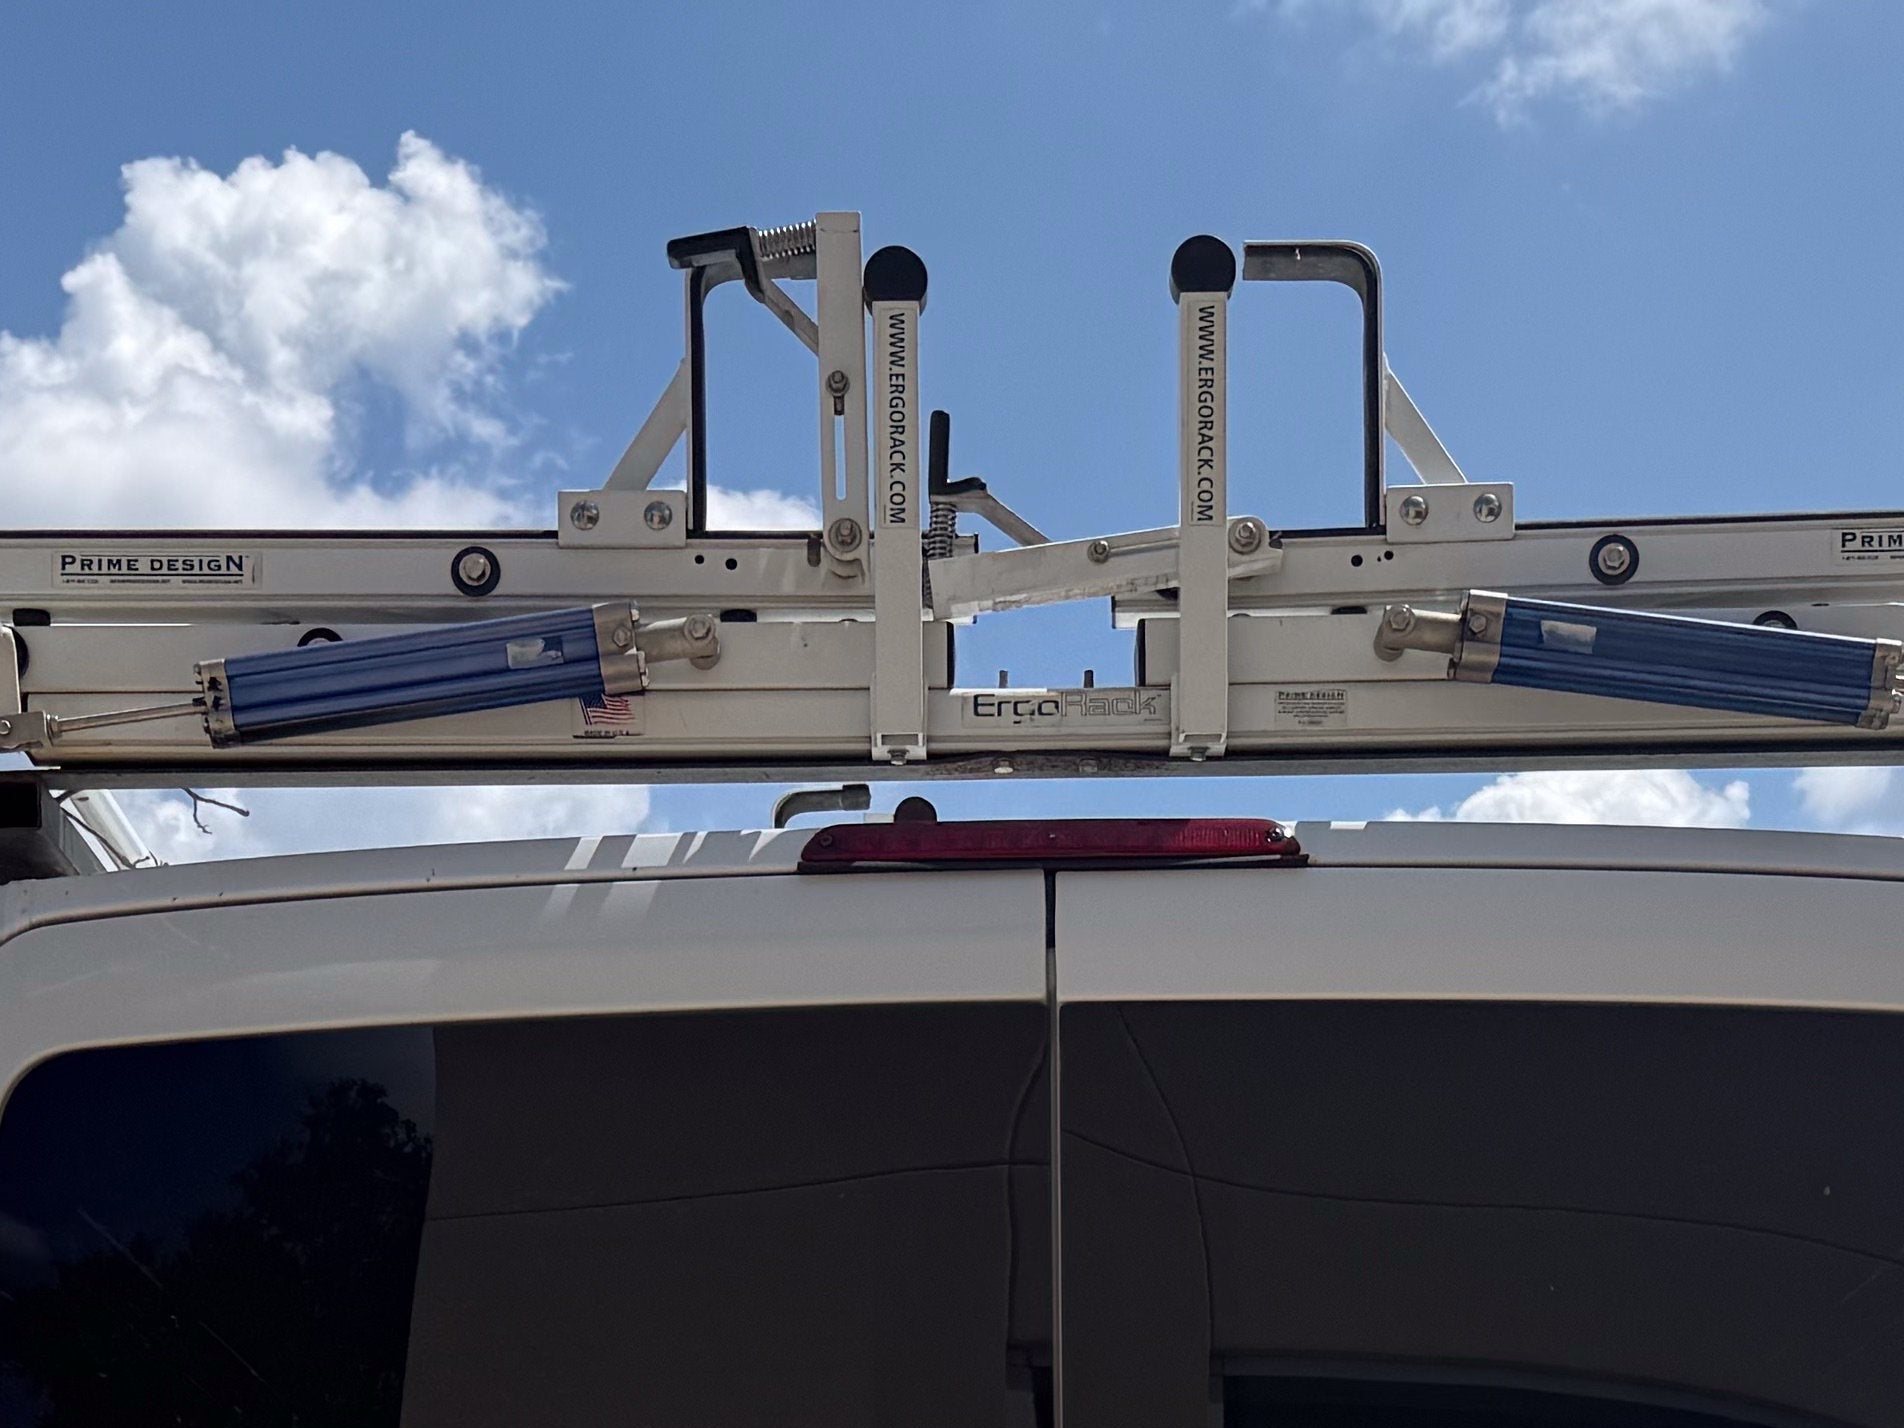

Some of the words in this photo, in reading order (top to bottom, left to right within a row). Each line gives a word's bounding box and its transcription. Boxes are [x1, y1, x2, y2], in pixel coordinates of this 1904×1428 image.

[889, 312, 906, 524] WWW.ERGORACK.COM
[1197, 305, 1215, 522] WWW.ERGORACK.COM
[60, 555, 140, 572] PRIME
